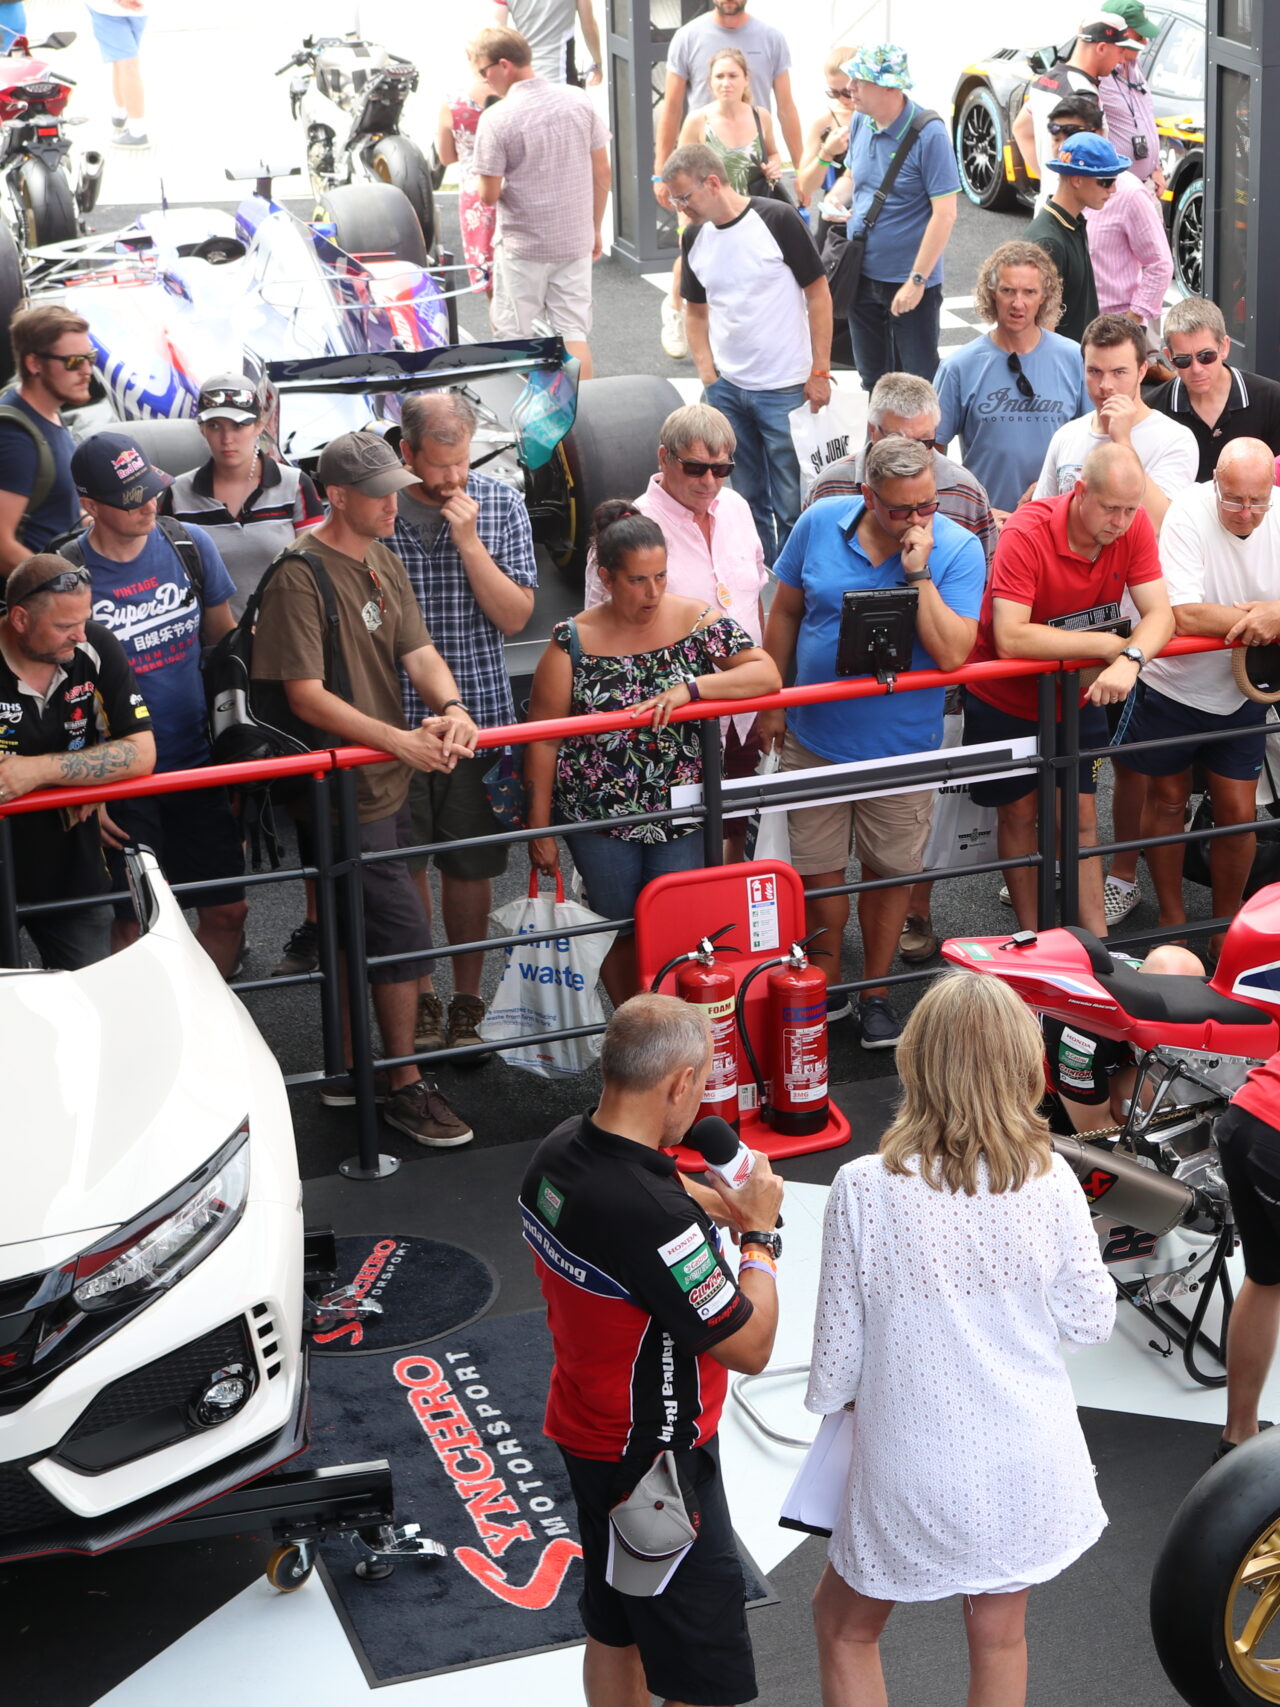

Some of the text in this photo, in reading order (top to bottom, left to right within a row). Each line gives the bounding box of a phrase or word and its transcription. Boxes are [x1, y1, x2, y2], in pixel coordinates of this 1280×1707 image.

[978, 387, 1064, 414] Indian
[116, 466, 134, 480] Red
[112, 576, 160, 599] VINTAGE
[519, 962, 586, 992] waste
[708, 1002, 732, 1015] FOAM
[1066, 1034, 1091, 1049] HONDA
[666, 1232, 698, 1256] HONDA
[371, 1242, 412, 1296] ORSPORT
[542, 1236, 588, 1284] Racing
[689, 1250, 709, 1270] Castrol
[689, 1267, 723, 1305] CLINTON
[445, 1350, 571, 1537] MOTORSPORT
[393, 1355, 584, 1611] SYNCHRO
